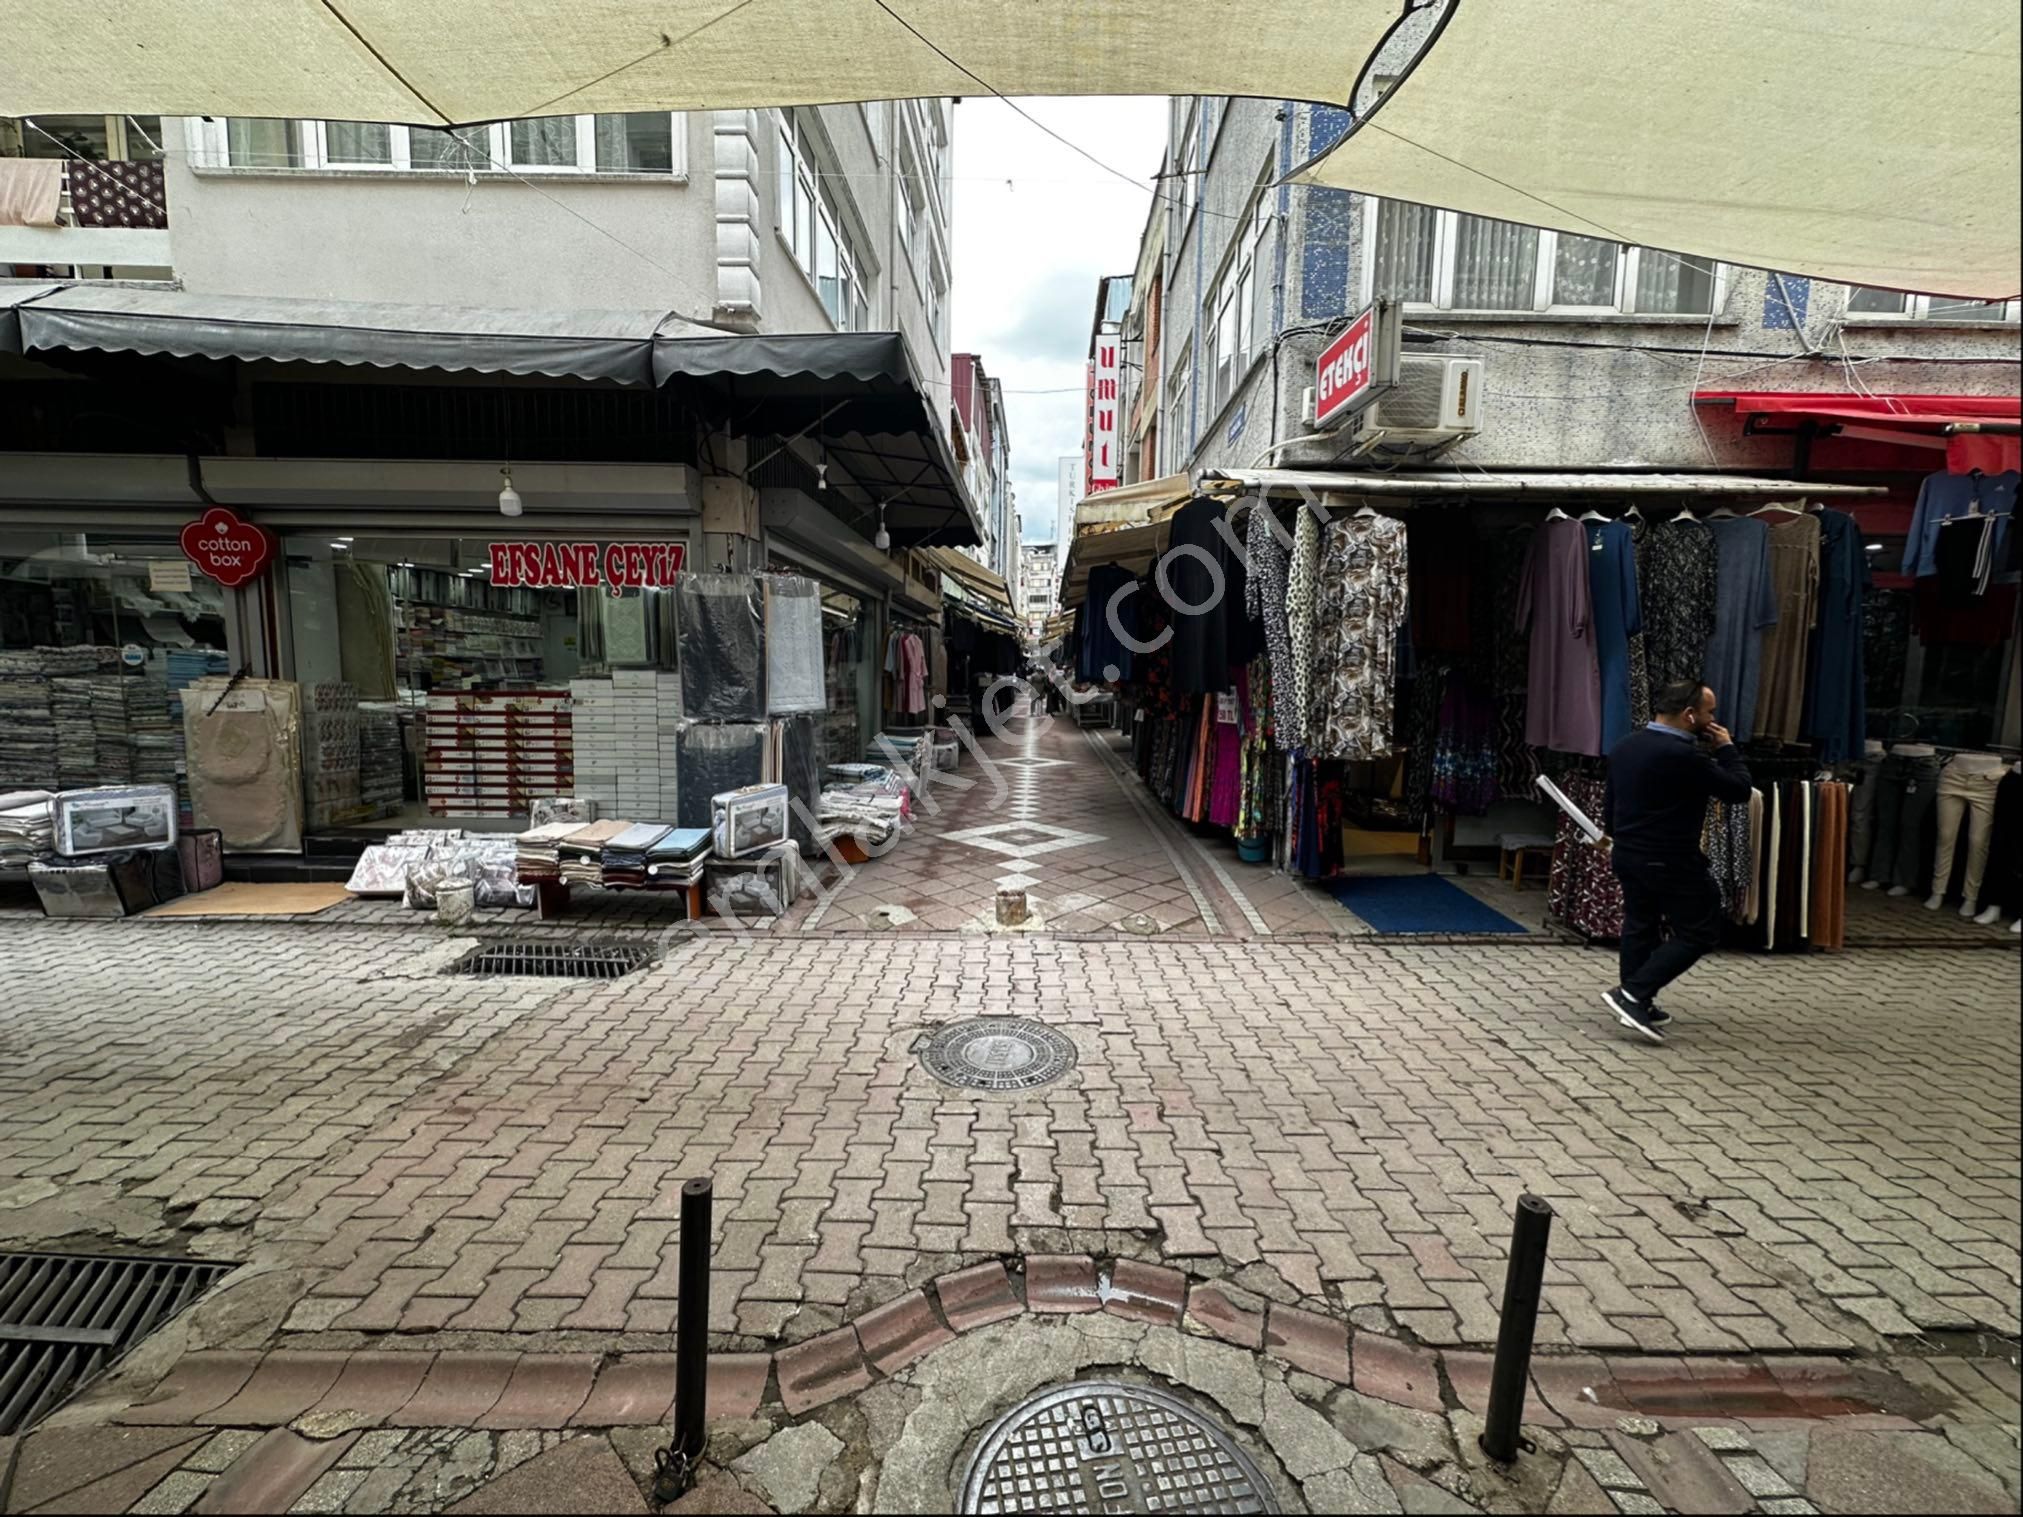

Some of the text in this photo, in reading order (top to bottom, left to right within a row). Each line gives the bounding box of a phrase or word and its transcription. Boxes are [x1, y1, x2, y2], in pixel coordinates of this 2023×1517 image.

[1098, 346, 1116, 467] umut
[198, 537, 251, 552] cotton
[210, 552, 242, 567] box
[489, 542, 600, 587] EFSANE
